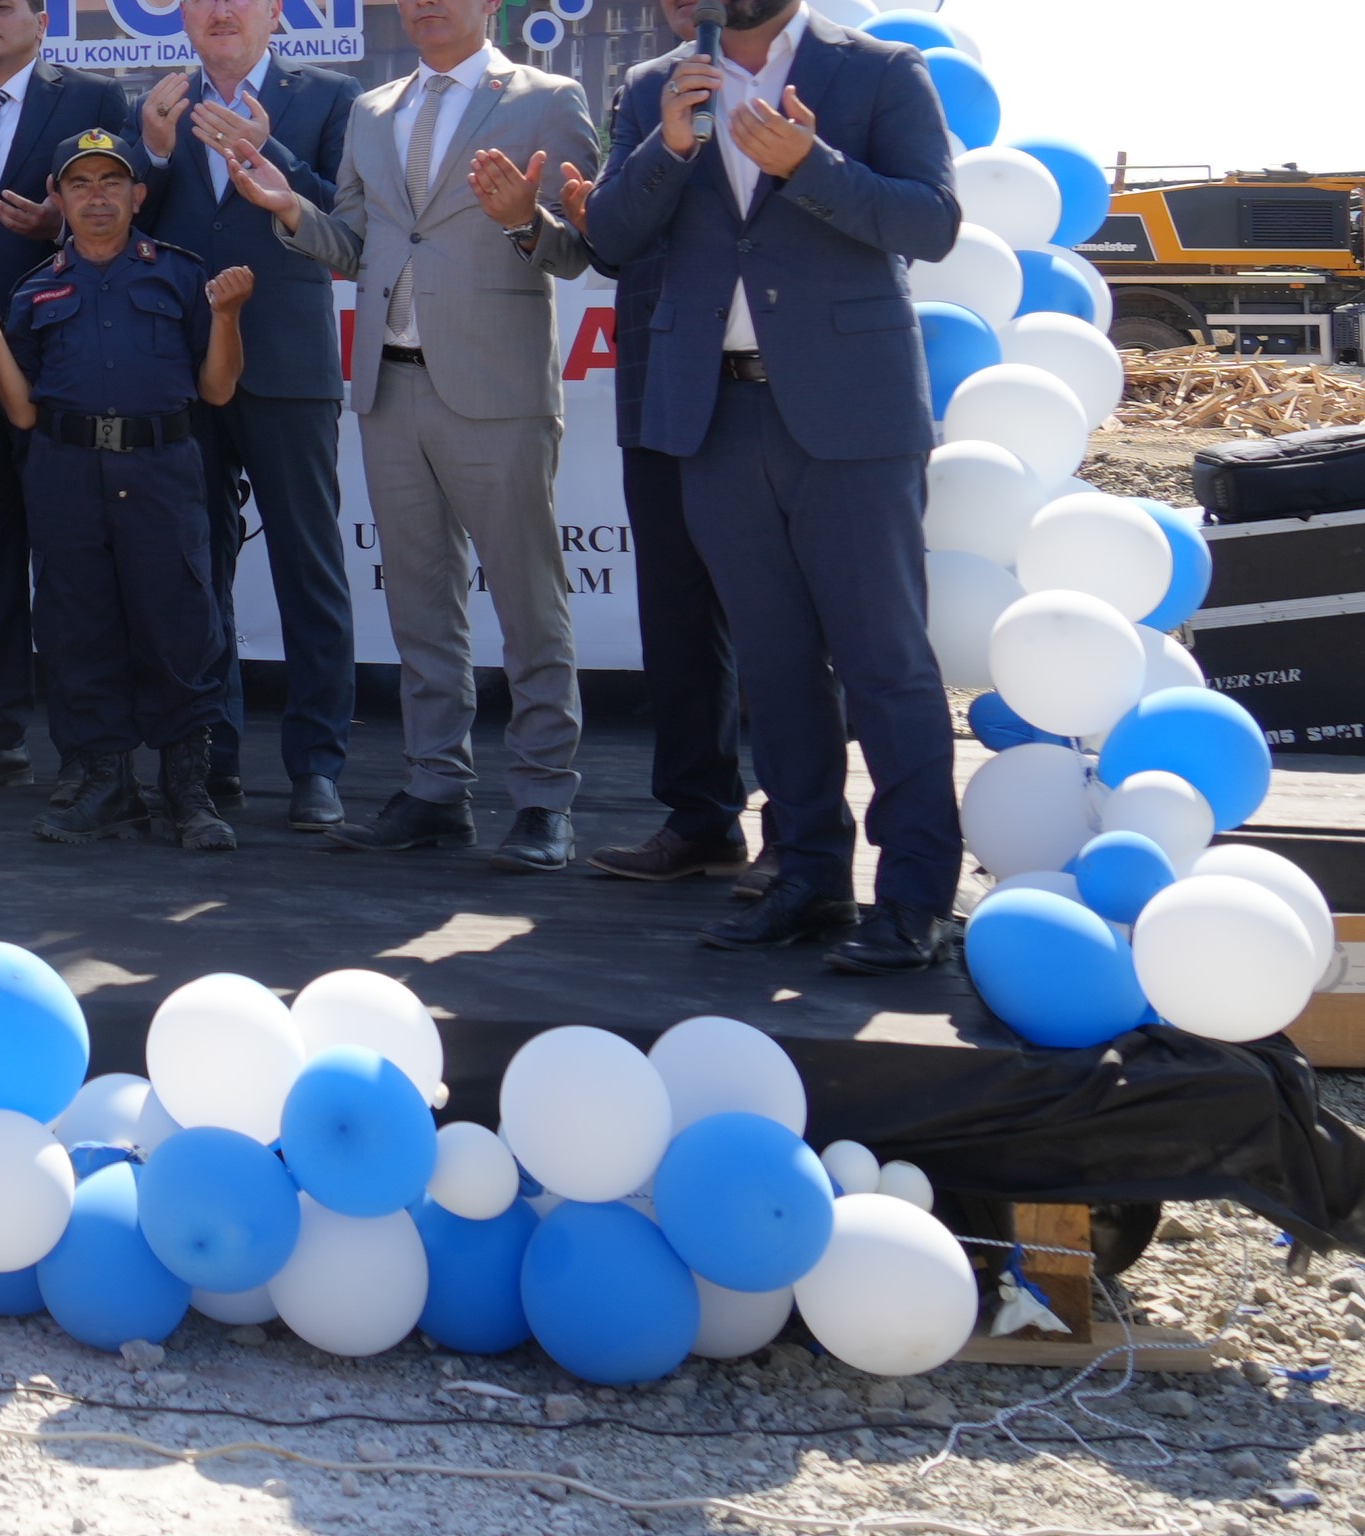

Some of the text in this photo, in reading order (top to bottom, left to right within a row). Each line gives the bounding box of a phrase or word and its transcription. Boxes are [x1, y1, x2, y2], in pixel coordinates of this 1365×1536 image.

[40, 46, 78, 63] PLU
[85, 45, 151, 62] KONUT
[1254, 668, 1301, 686] STAR
